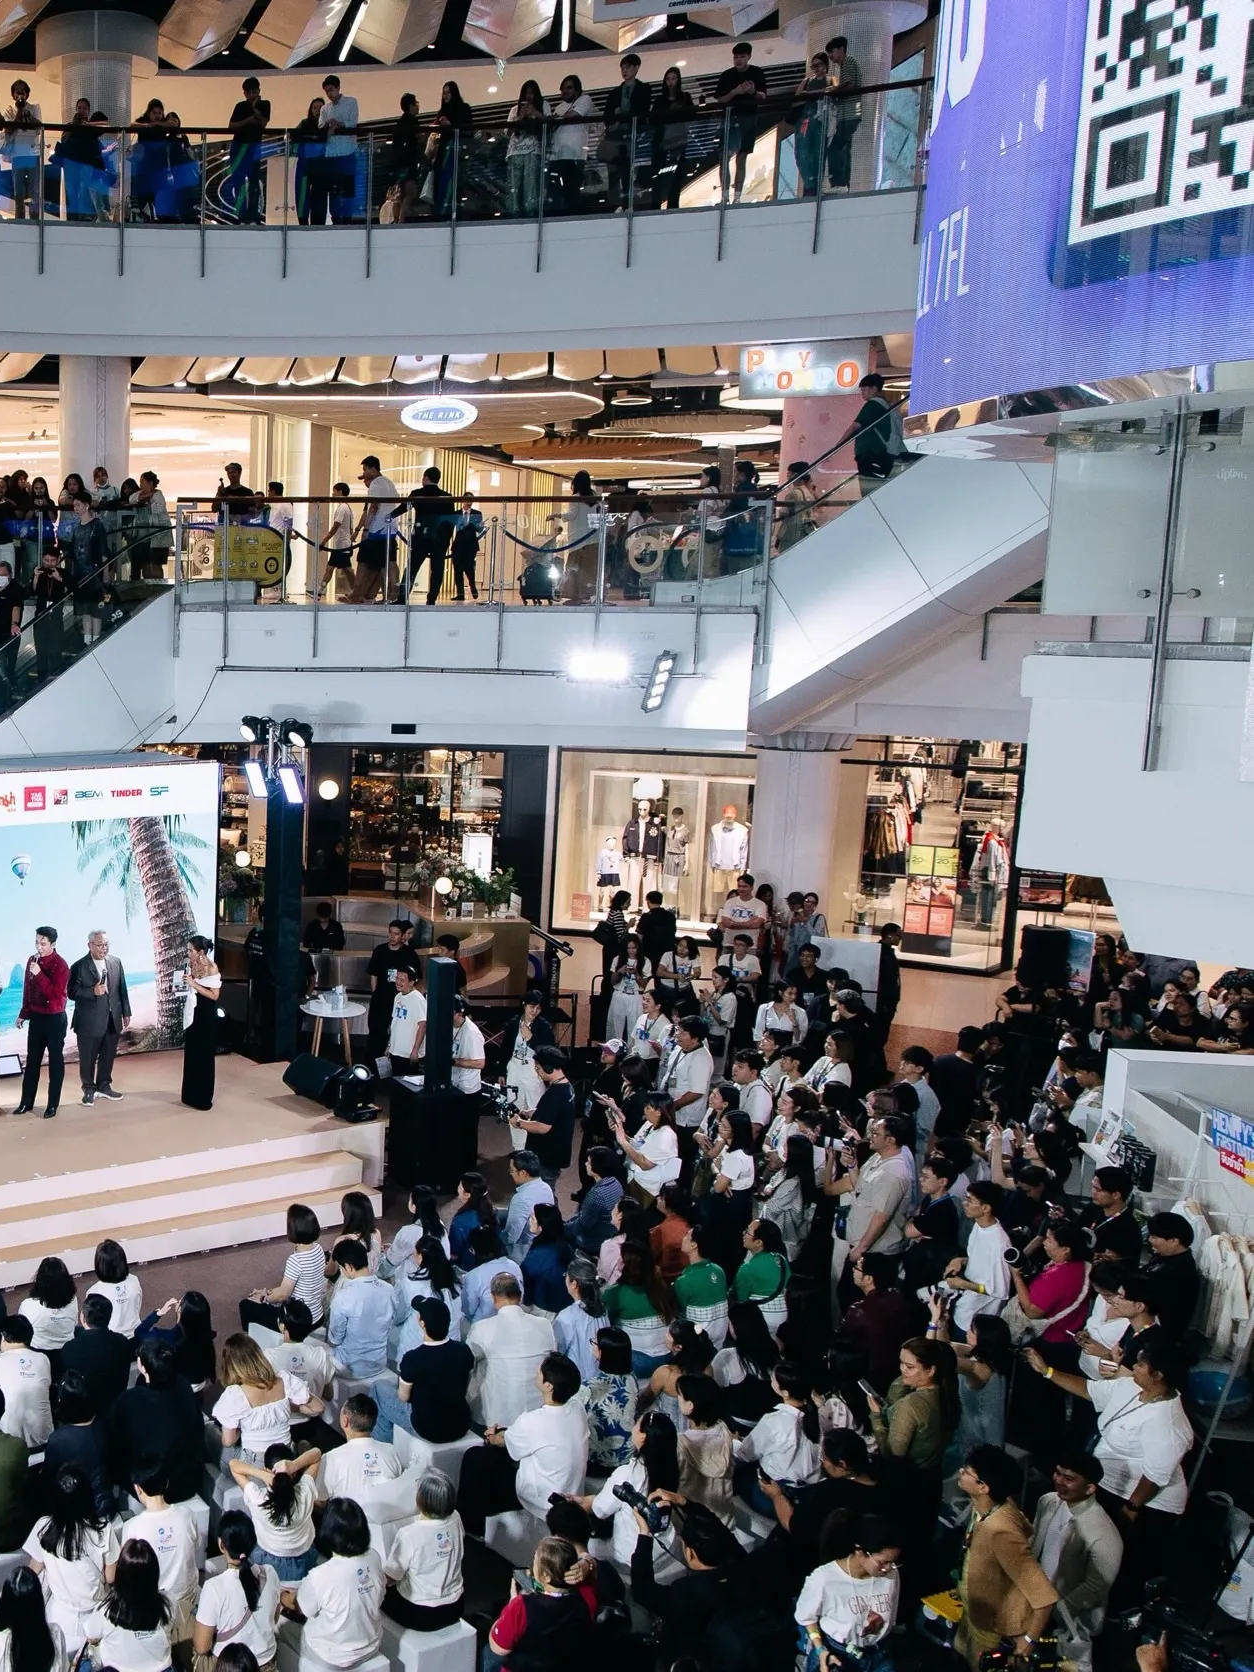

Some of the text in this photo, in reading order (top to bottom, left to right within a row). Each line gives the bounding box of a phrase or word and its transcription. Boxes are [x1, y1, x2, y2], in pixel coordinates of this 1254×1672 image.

[747, 349, 811, 374] PY
[417, 410, 462, 420] THE RINK
[110, 789, 143, 798] TINDER
[149, 786, 170, 797] SF
[848, 1593, 893, 1615] GINGER
